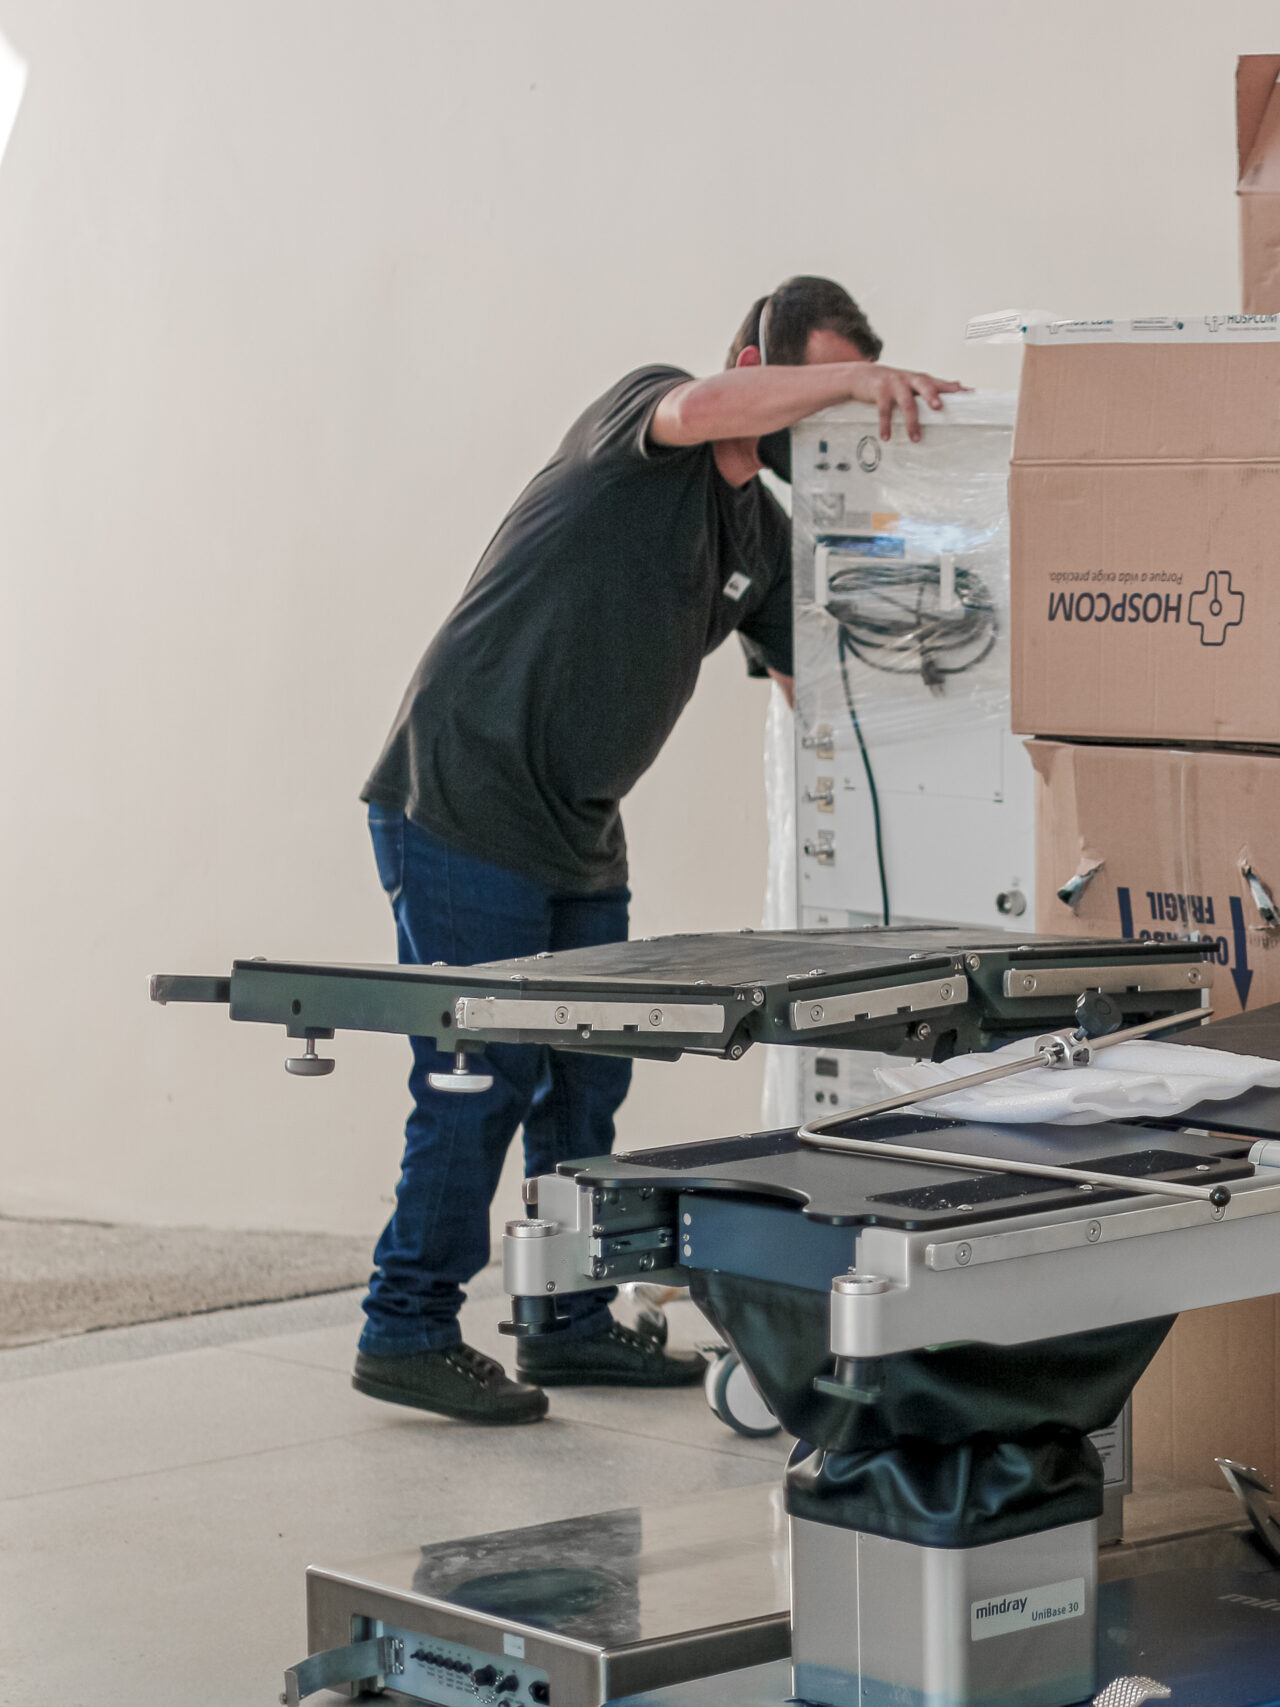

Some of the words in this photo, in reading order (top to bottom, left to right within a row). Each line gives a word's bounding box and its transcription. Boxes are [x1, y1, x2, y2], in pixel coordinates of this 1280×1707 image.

[1150, 572, 1183, 585] Porque
[1048, 592, 1182, 623] HOSPCOM
[976, 1597, 1028, 1619] mindray
[1031, 1605, 1067, 1621] UniBase
[1068, 1602, 1079, 1614] 30
